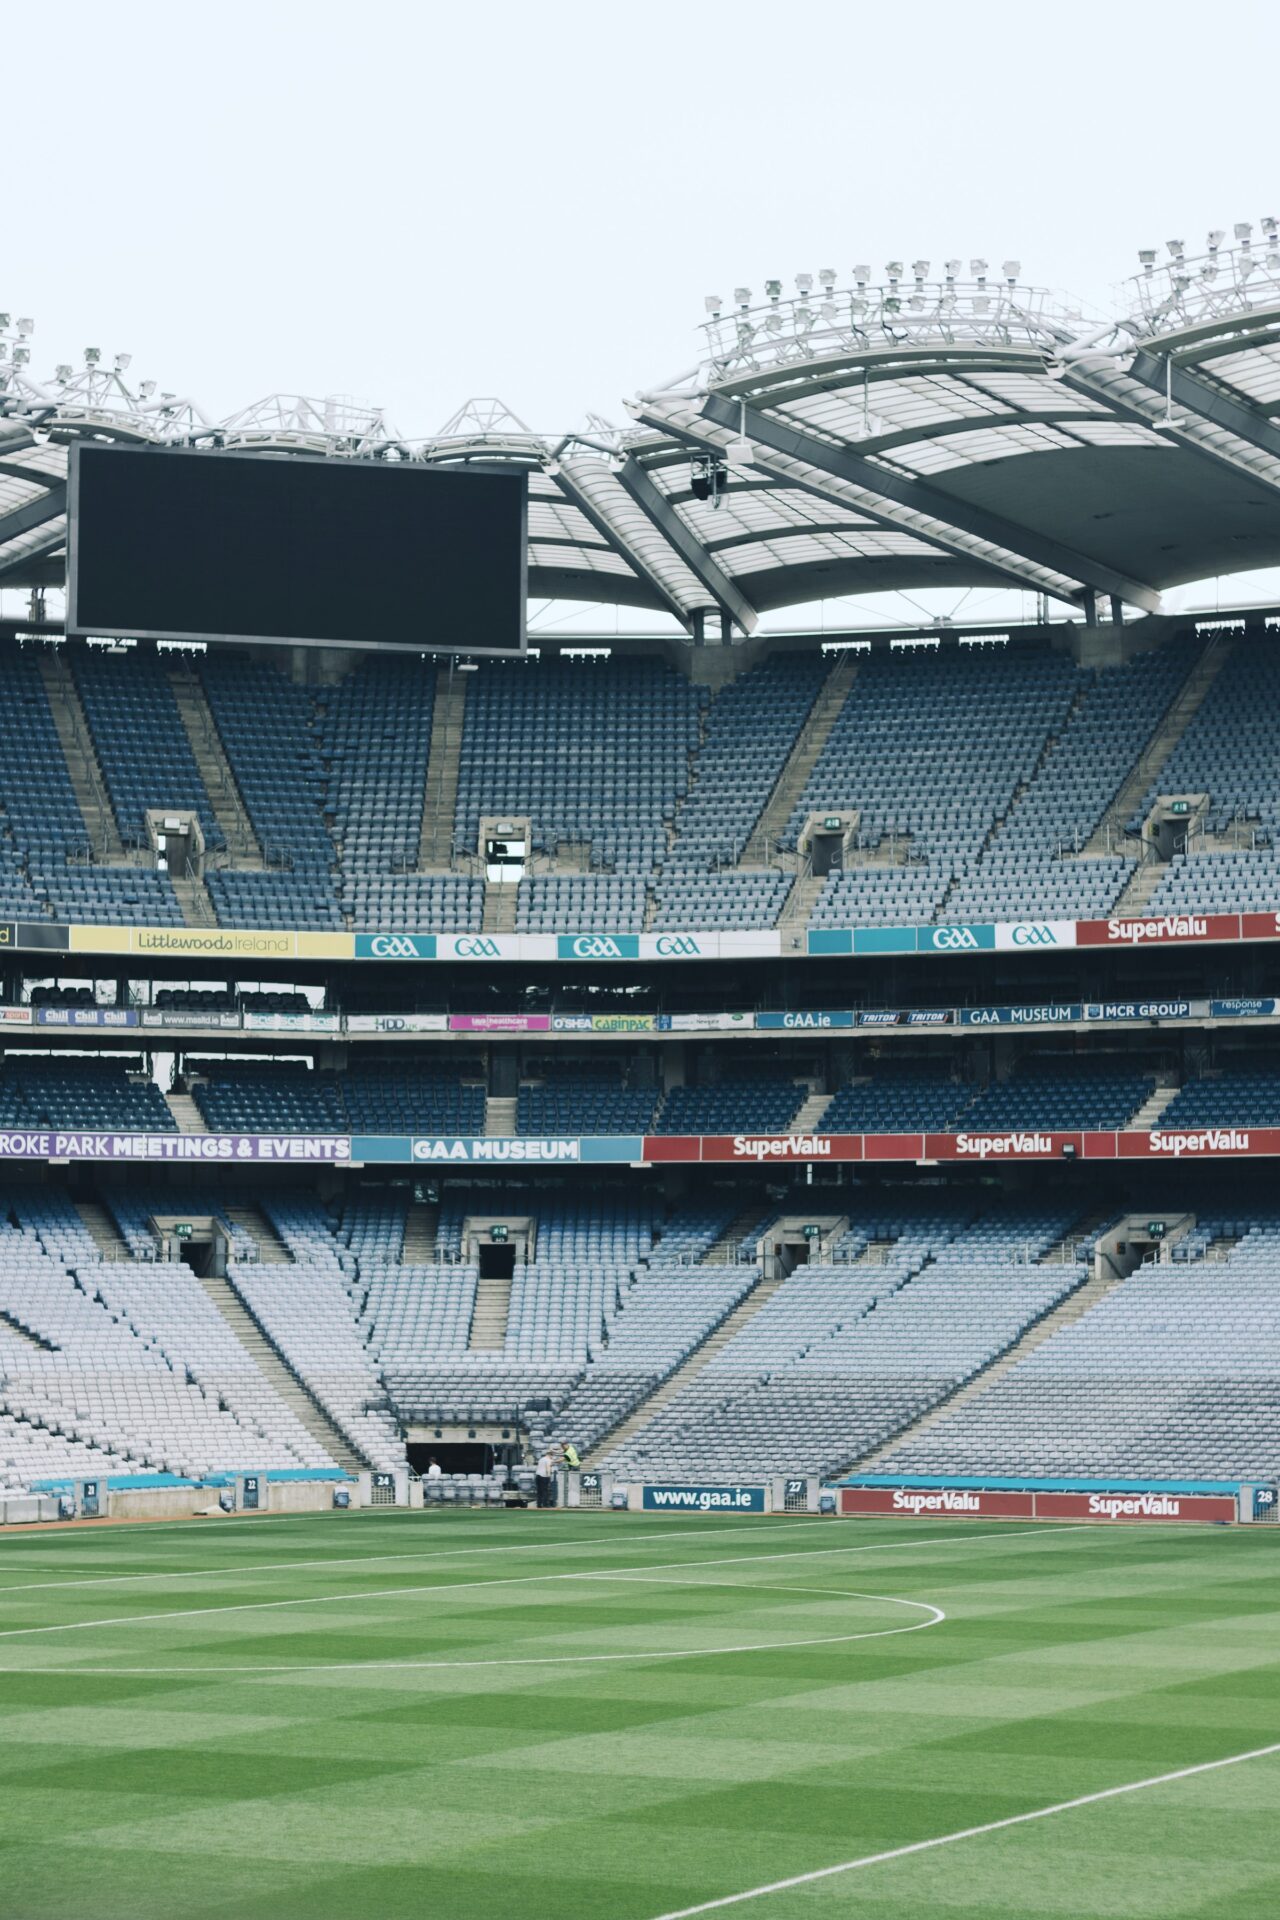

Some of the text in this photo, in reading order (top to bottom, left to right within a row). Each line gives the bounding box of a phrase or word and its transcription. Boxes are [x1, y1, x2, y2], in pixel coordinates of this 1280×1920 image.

[932, 928, 979, 949] GAA
[1012, 925, 1058, 945] GAA
[1107, 916, 1207, 943] SuperValu
[139, 933, 288, 951] Littlewoods Ireland
[371, 936, 420, 957] GAA
[454, 937, 501, 956] GAA
[573, 936, 622, 957] GAA
[656, 936, 701, 955] GAA
[1106, 1005, 1135, 1017] MCR
[1139, 1004, 1188, 1016] GROUP
[1221, 1000, 1263, 1010] response
[45, 1010, 69, 1020] Chill
[74, 1010, 98, 1020] Chill
[104, 1011, 127, 1021] Chill
[375, 1017, 405, 1030] HDD
[553, 1017, 592, 1029] O'SHEA
[783, 1012, 831, 1027] GAA.ie
[911, 1013, 945, 1021] TRITON
[970, 1007, 1071, 1023] GAA MUSEUM
[55, 1135, 109, 1155] PARK
[113, 1137, 233, 1157] MEETINGS
[236, 1138, 253, 1157] &
[258, 1138, 350, 1158] EVENTS
[414, 1140, 578, 1159] GAA MUSEUM
[733, 1136, 831, 1160] SuperValu
[956, 1133, 1052, 1158] SuperValu
[1149, 1130, 1249, 1156] SuperValu
[247, 1480, 256, 1489] 22
[377, 1476, 390, 1486] 24
[583, 1475, 598, 1486] 26
[788, 1481, 803, 1492] 27
[652, 1488, 752, 1510] www.gaa.ie
[892, 1490, 980, 1514] SuperValu
[1257, 1490, 1273, 1502] 28
[1088, 1495, 1180, 1519] SuperValu
